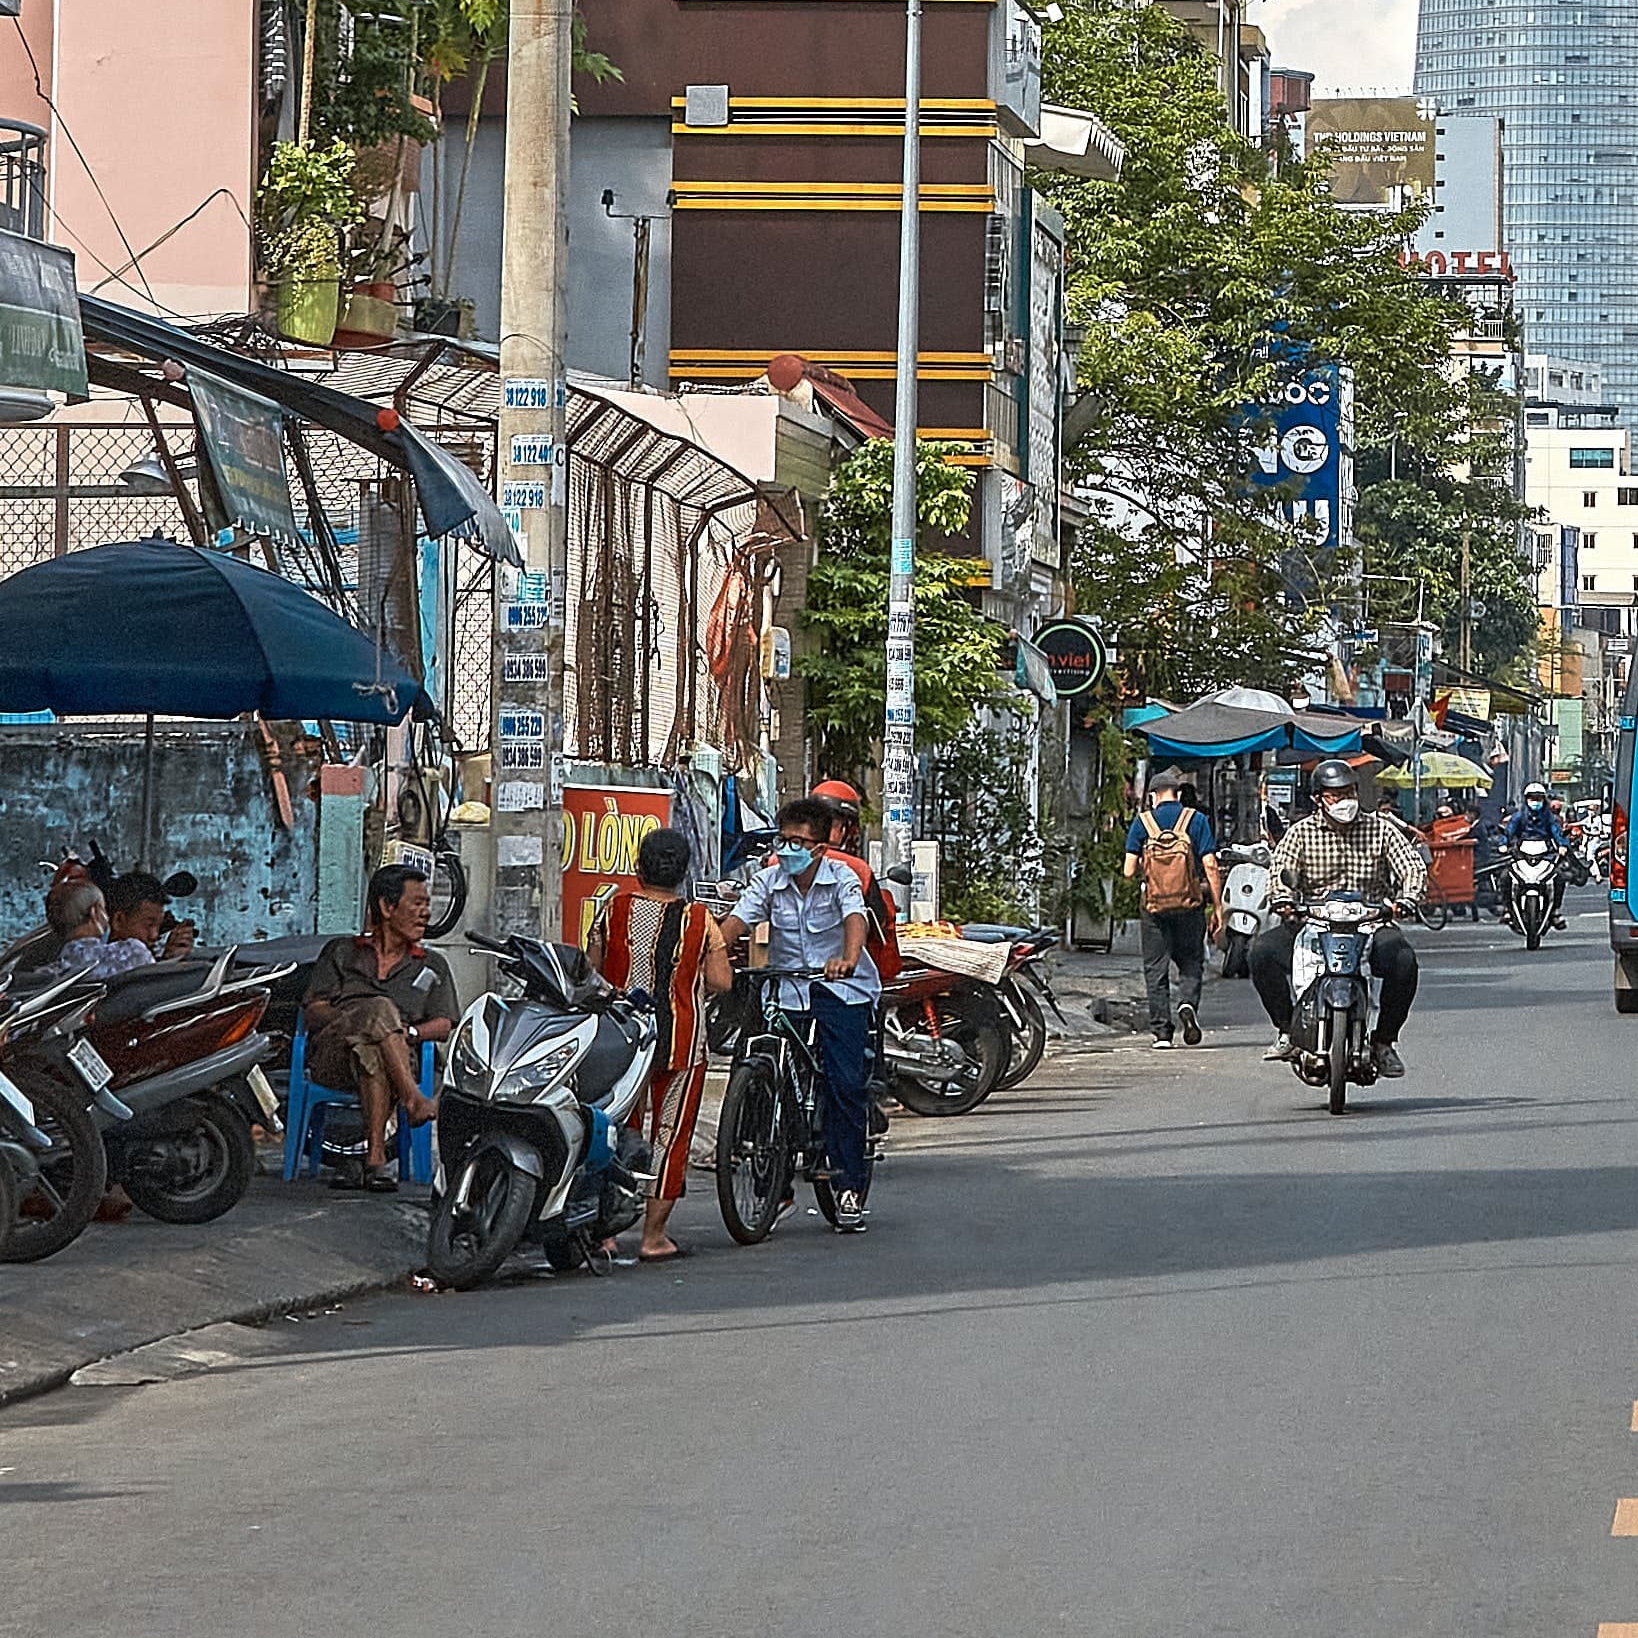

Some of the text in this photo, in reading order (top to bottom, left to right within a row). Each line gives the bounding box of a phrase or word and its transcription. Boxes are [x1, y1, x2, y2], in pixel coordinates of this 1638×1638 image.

[1384, 131, 1426, 143] VIETNAM
[515, 387, 530, 407] 122
[530, 387, 547, 407] 918
[523, 444, 537, 463] 122
[513, 488, 527, 508] 122
[528, 488, 544, 509] 918
